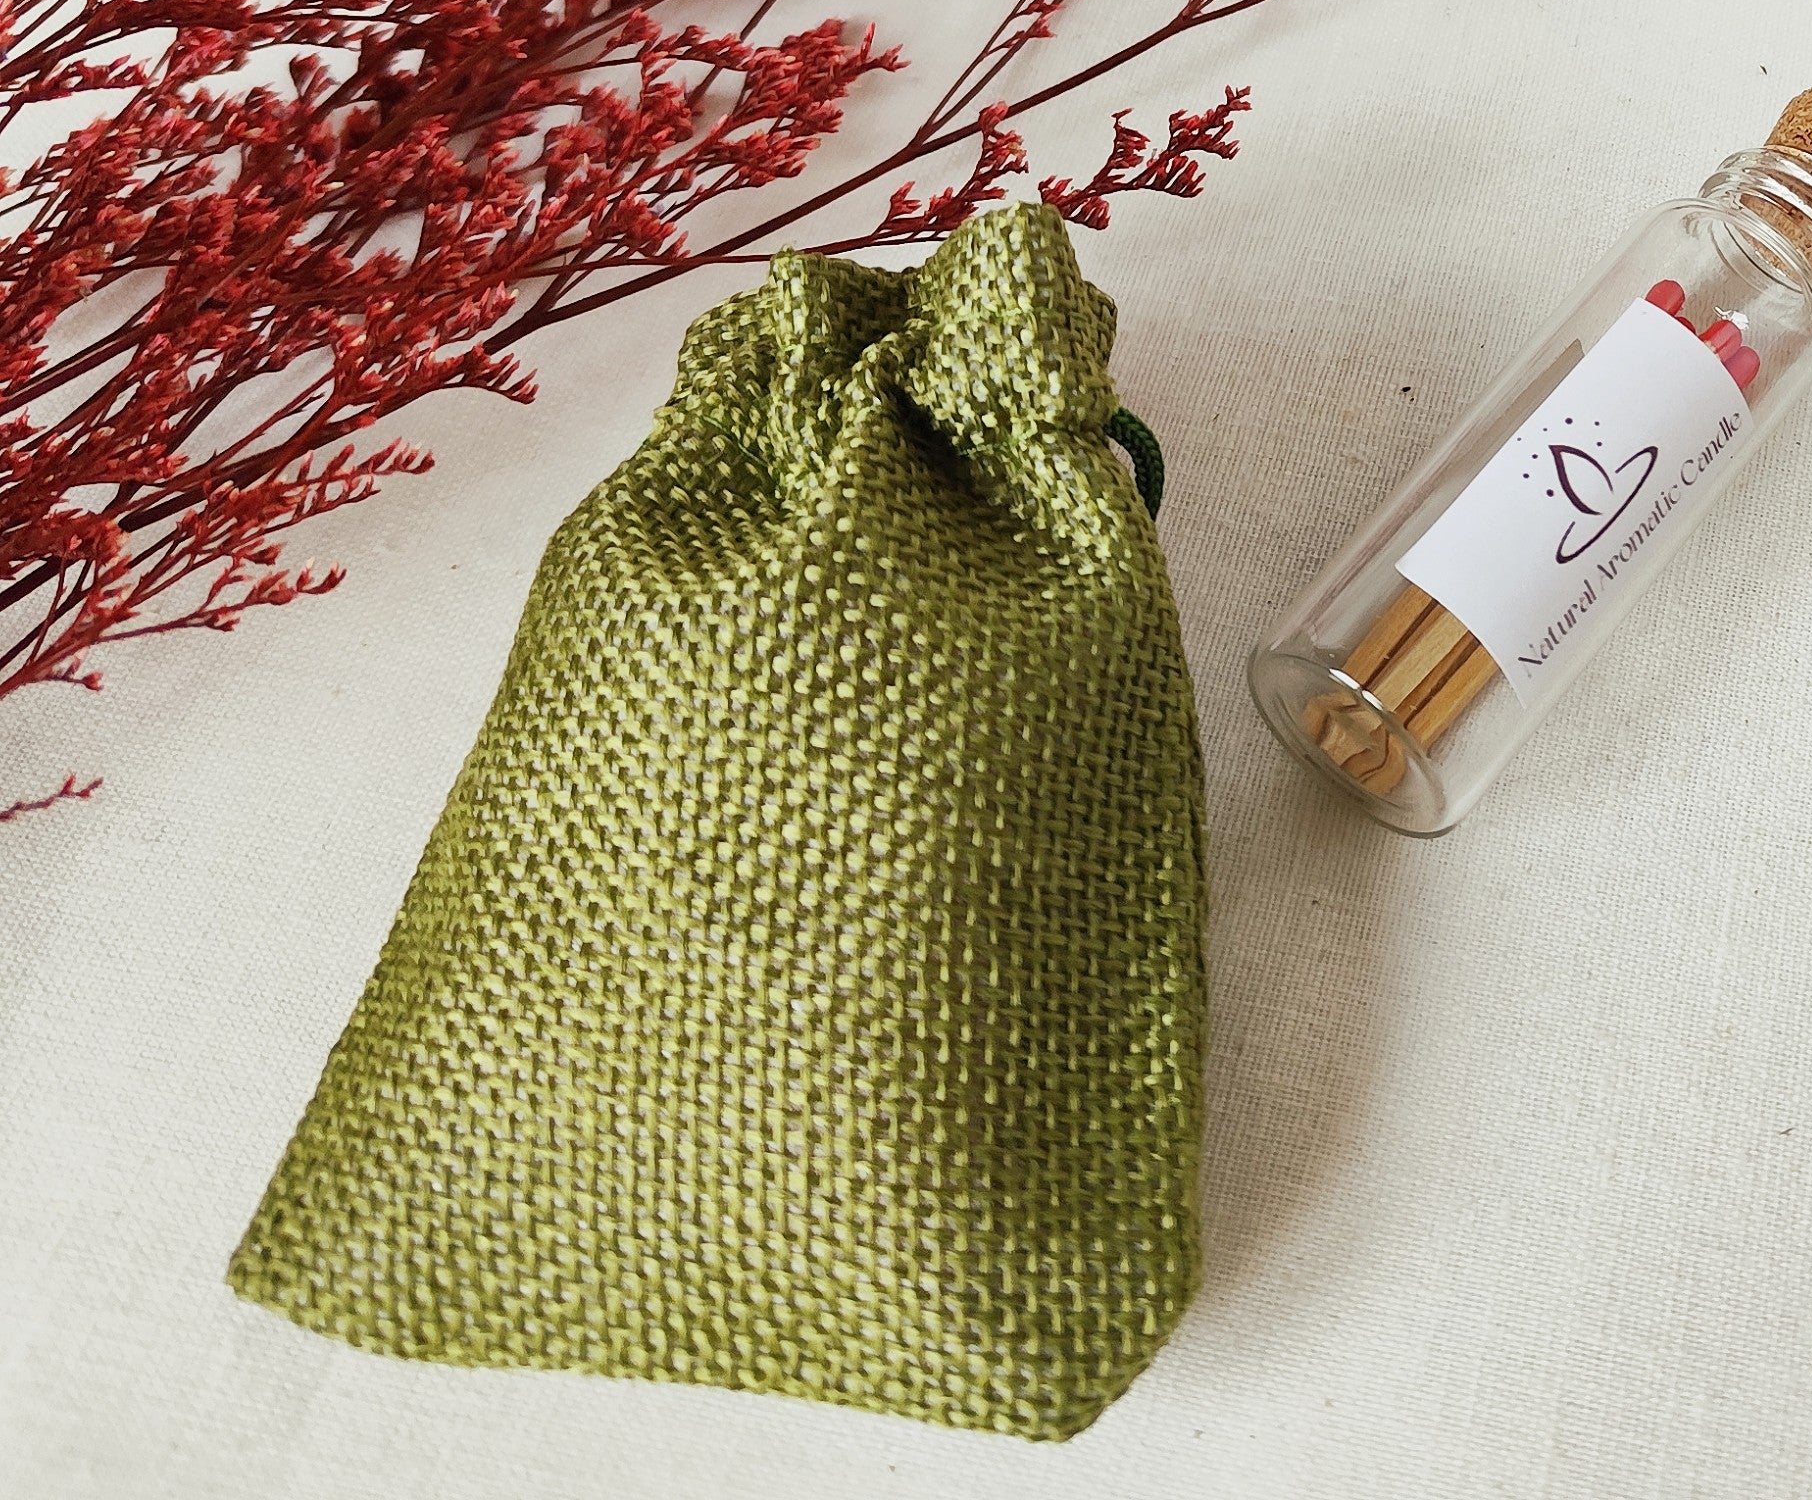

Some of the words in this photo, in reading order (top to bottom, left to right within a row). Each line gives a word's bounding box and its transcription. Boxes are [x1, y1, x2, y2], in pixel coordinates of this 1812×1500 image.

[1517, 578, 1599, 678] Natural
[1597, 483, 1683, 589] Aromatic
[1679, 411, 1742, 487] Candle
